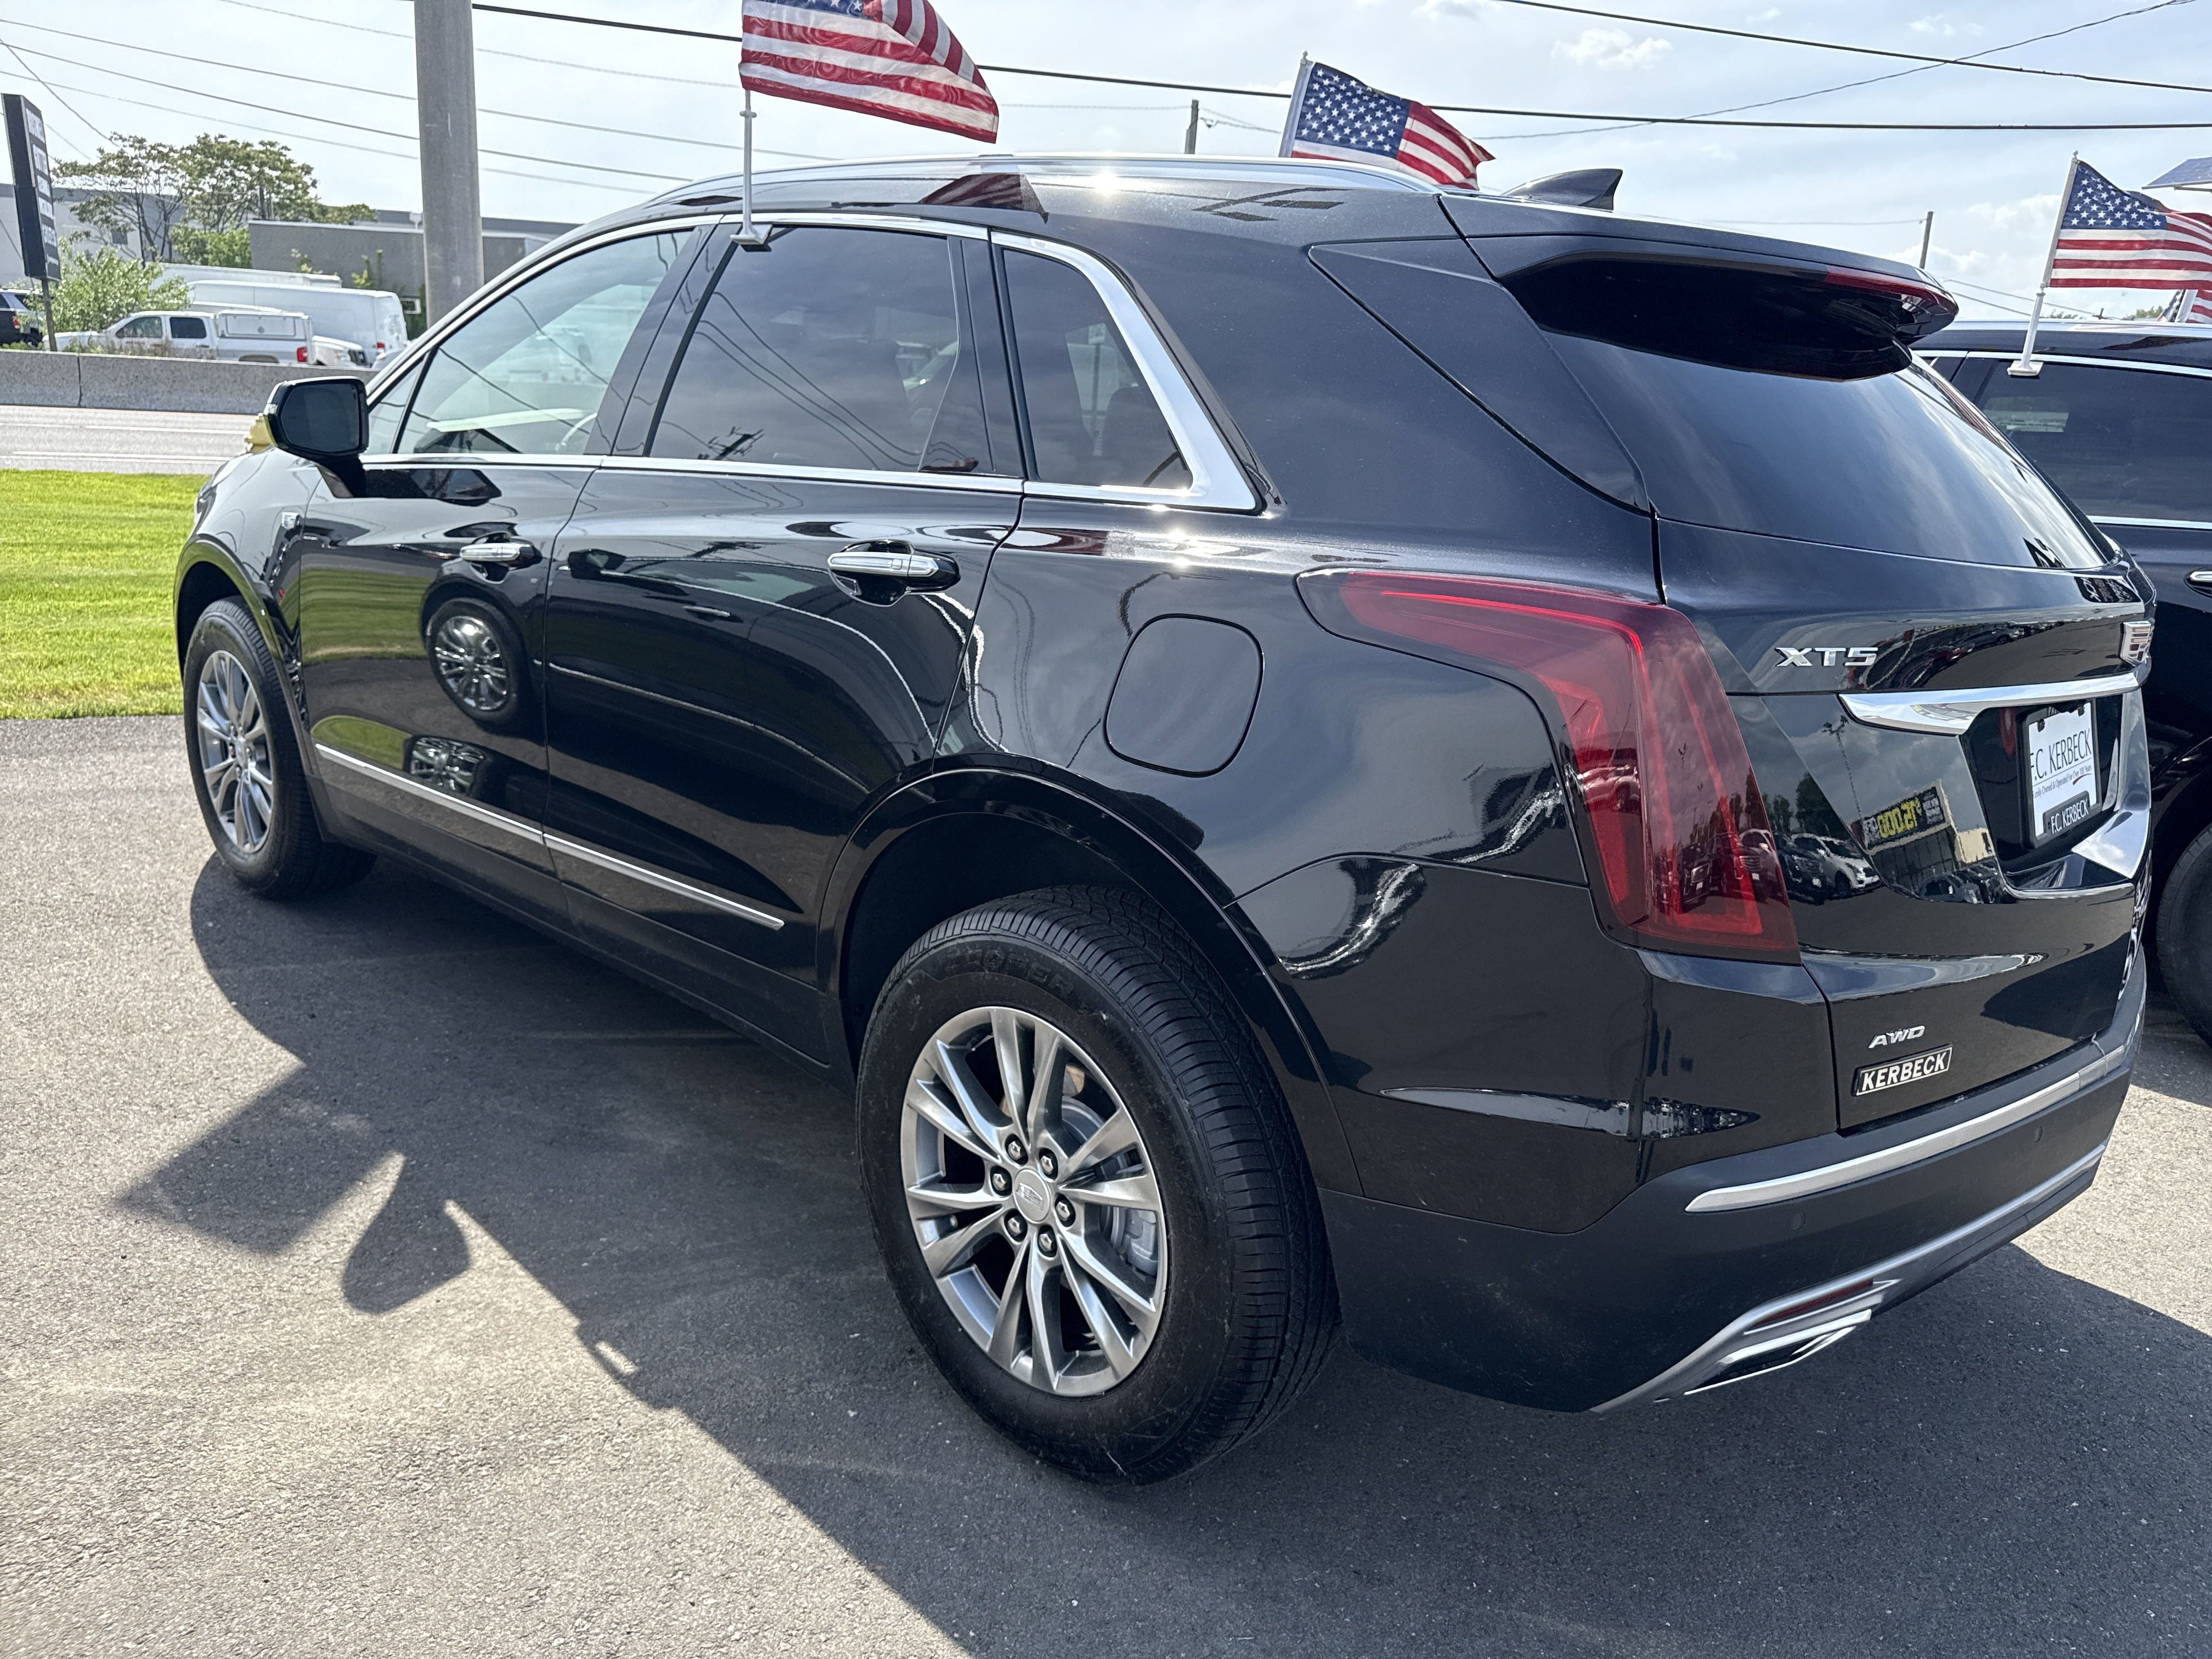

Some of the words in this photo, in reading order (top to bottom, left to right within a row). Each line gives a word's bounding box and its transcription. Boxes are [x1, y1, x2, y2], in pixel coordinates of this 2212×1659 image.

[1775, 647, 1878, 667] XT5
[2049, 728, 2092, 774] KERBECK
[2042, 781, 2052, 794] Owned
[2056, 774, 2068, 789] Operated
[2051, 814, 2062, 834] F.C.
[2062, 798, 2089, 828] KERBECK
[1868, 1025, 1925, 1048] AWD
[1861, 1051, 1948, 1092] KERBECK
